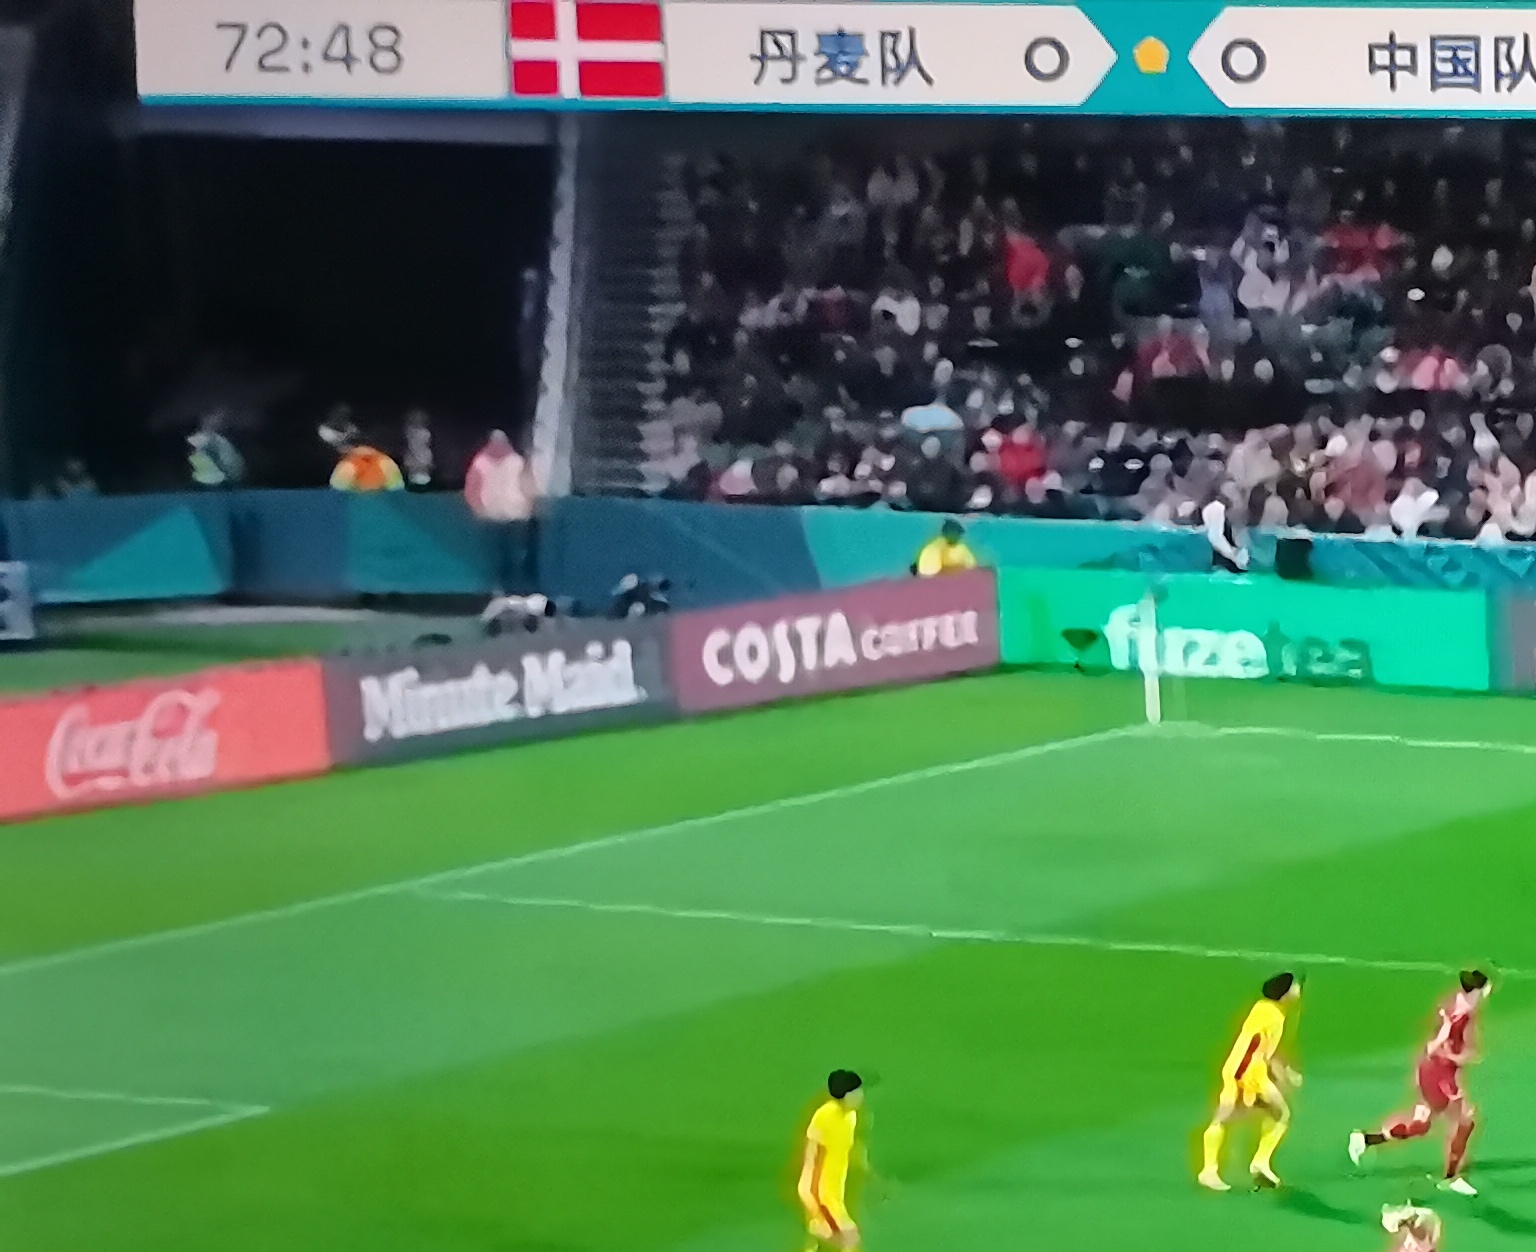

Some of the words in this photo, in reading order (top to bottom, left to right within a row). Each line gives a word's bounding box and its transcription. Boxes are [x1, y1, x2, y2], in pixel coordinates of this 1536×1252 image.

[214, 22, 404, 75] 72:48
[750, 26, 936, 88] 丹麦队
[702, 611, 858, 686] COSTA
